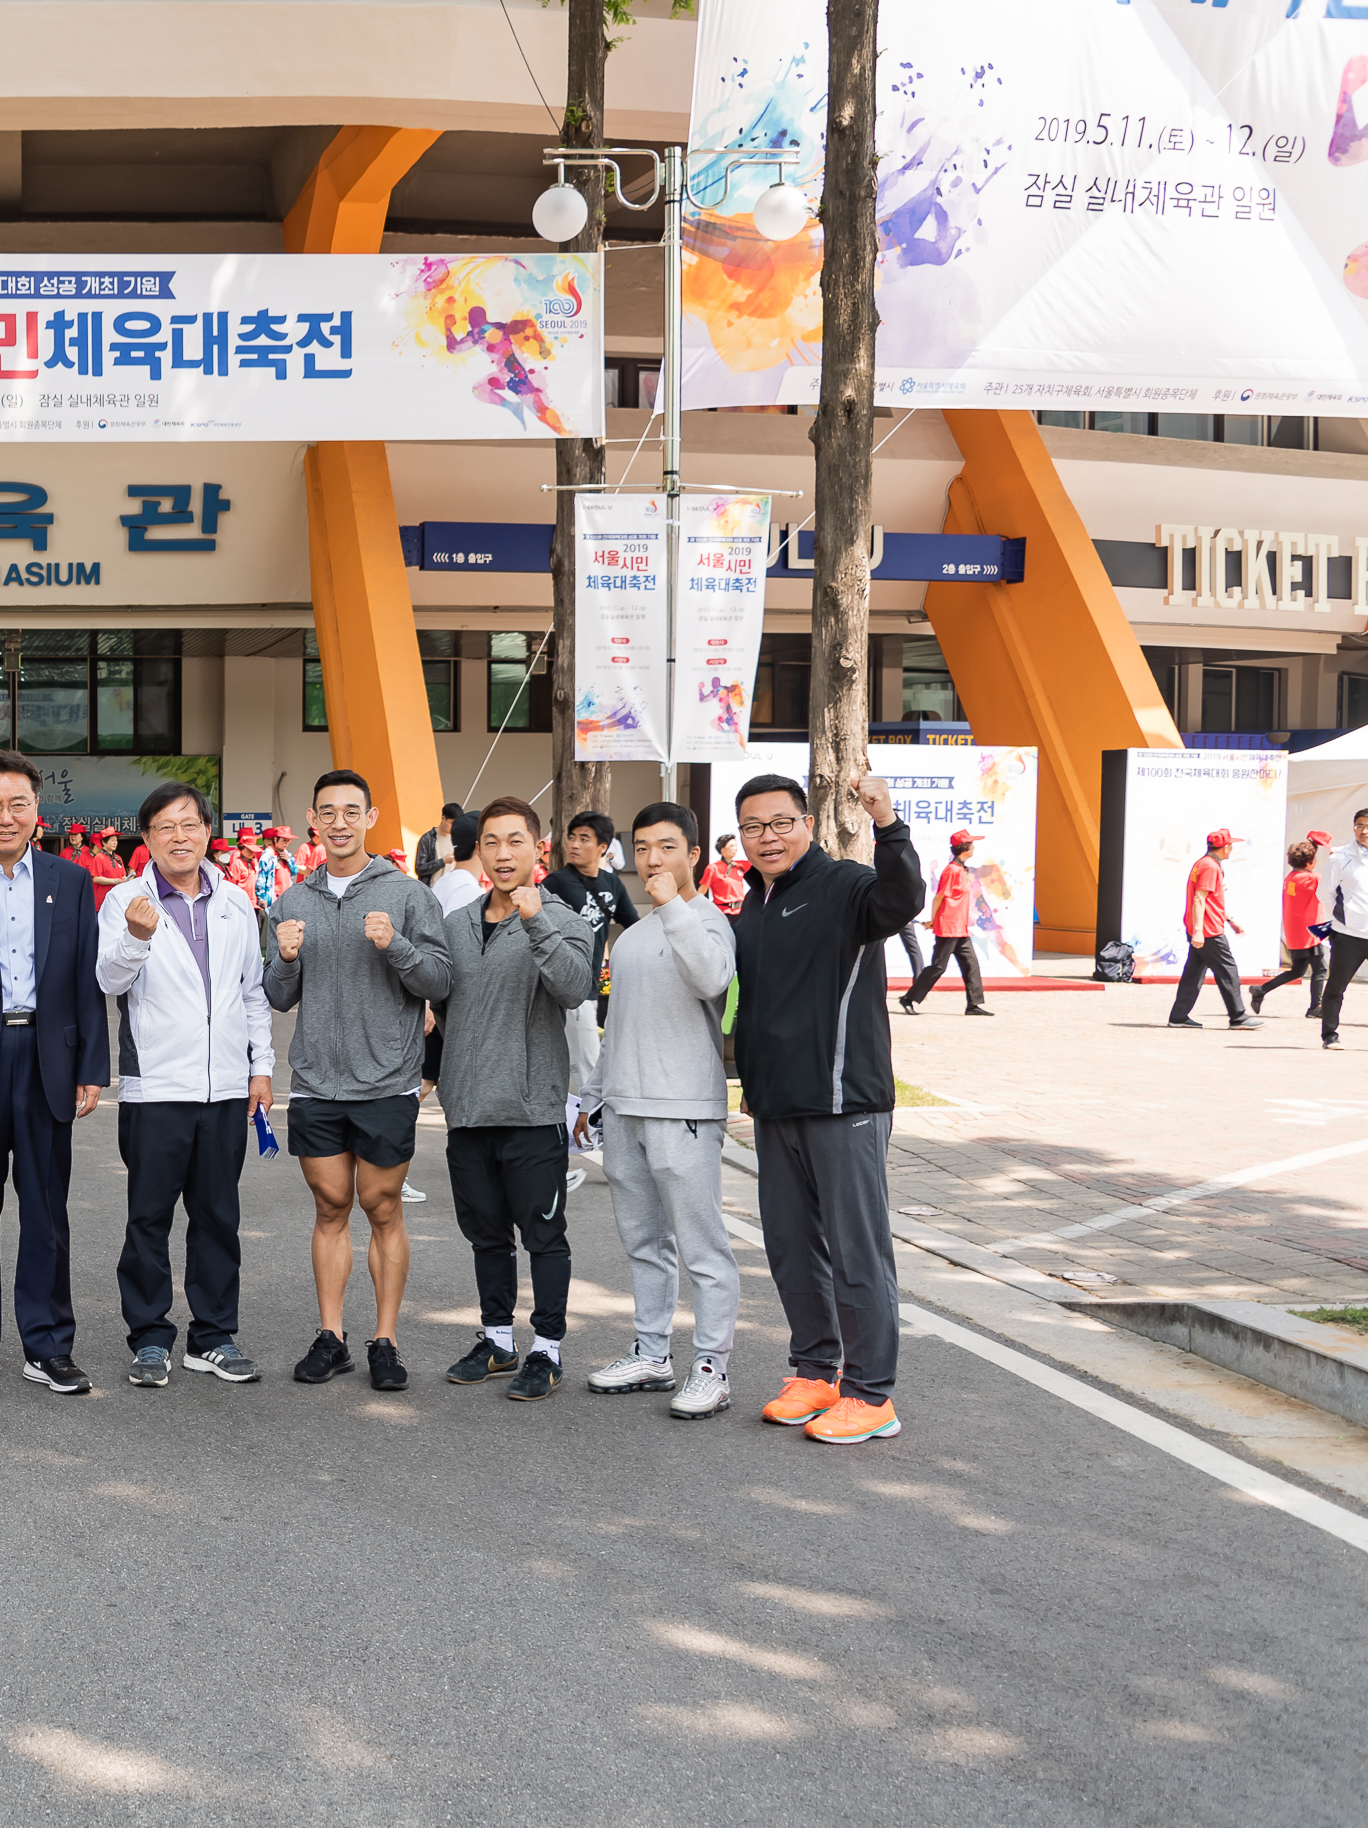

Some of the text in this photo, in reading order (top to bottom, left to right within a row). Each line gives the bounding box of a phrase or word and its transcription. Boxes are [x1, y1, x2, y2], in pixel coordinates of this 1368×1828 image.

[1024, 172, 1277, 221] 잠실 실내체육관 일원
[39, 276, 78, 296] 성공
[81, 276, 119, 296] 개최
[123, 276, 161, 297] 기원
[539, 320, 588, 329] SEOUL 2019
[1012, 384, 1032, 395] 25개
[1095, 386, 1142, 399] 서울특별시
[38, 393, 159, 408] 잠실 실내체육관 일원
[623, 543, 648, 553] 2019
[728, 547, 752, 556] 2019
[468, 552, 493, 564] 출입구
[958, 563, 981, 575] 출입구
[1155, 524, 1339, 613] TICKET
[586, 574, 656, 591] 체육대축전
[689, 577, 757, 593] 체육대축전
[1137, 767, 1172, 777] 제100회
[1175, 768, 1229, 778] 전국체육대회
[255, 822, 263, 835] 3
